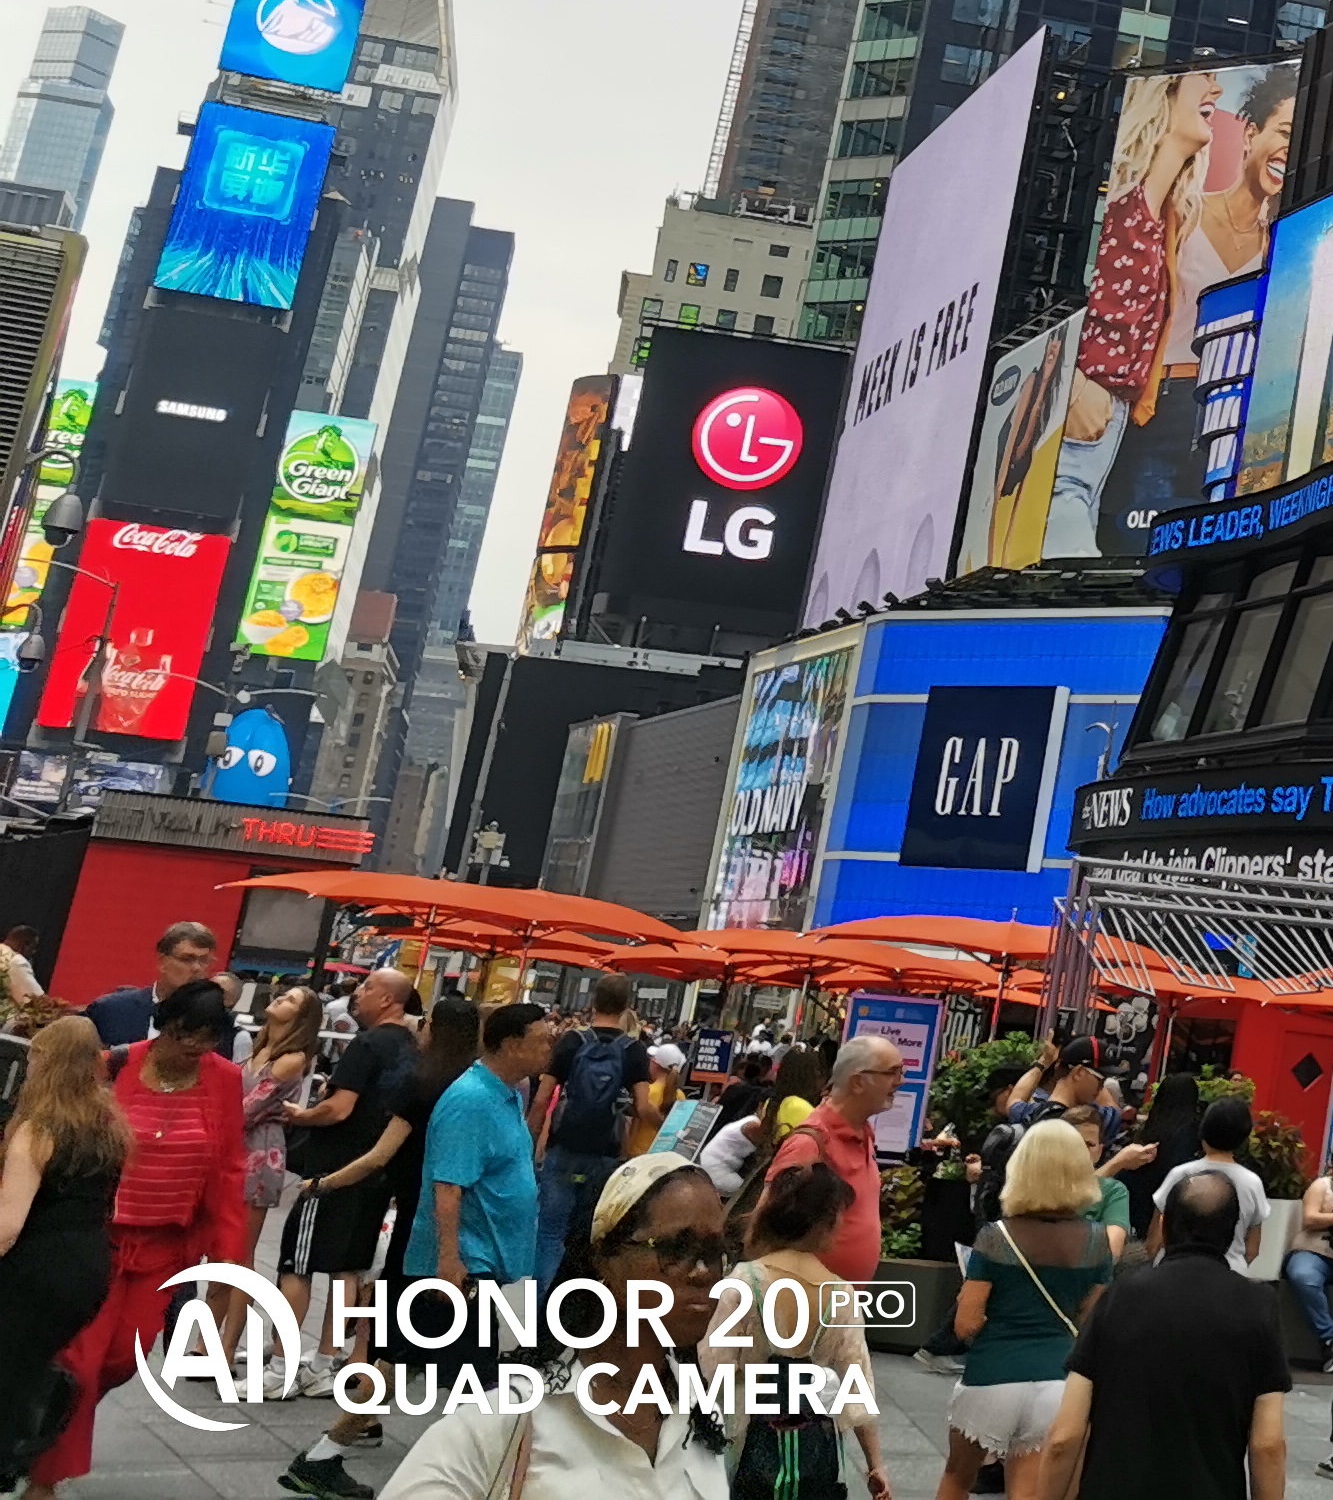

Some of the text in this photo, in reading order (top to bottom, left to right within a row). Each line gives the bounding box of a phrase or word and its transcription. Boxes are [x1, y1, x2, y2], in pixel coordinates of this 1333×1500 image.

[901, 321, 927, 394] IS
[926, 281, 980, 378] FREE
[156, 400, 228, 422] SAMSUNG
[288, 459, 352, 483] Green
[291, 476, 350, 501] Giant
[682, 498, 777, 564] LG
[1186, 503, 1264, 548] LEADER,
[934, 736, 1020, 818] GAP
[731, 781, 809, 838] OLD NAVY
[1089, 786, 1134, 829] NEWS
[1140, 787, 1176, 821] How
[1177, 782, 1267, 818] advocates
[1271, 784, 1315, 821] say
[241, 816, 317, 848] THRU
